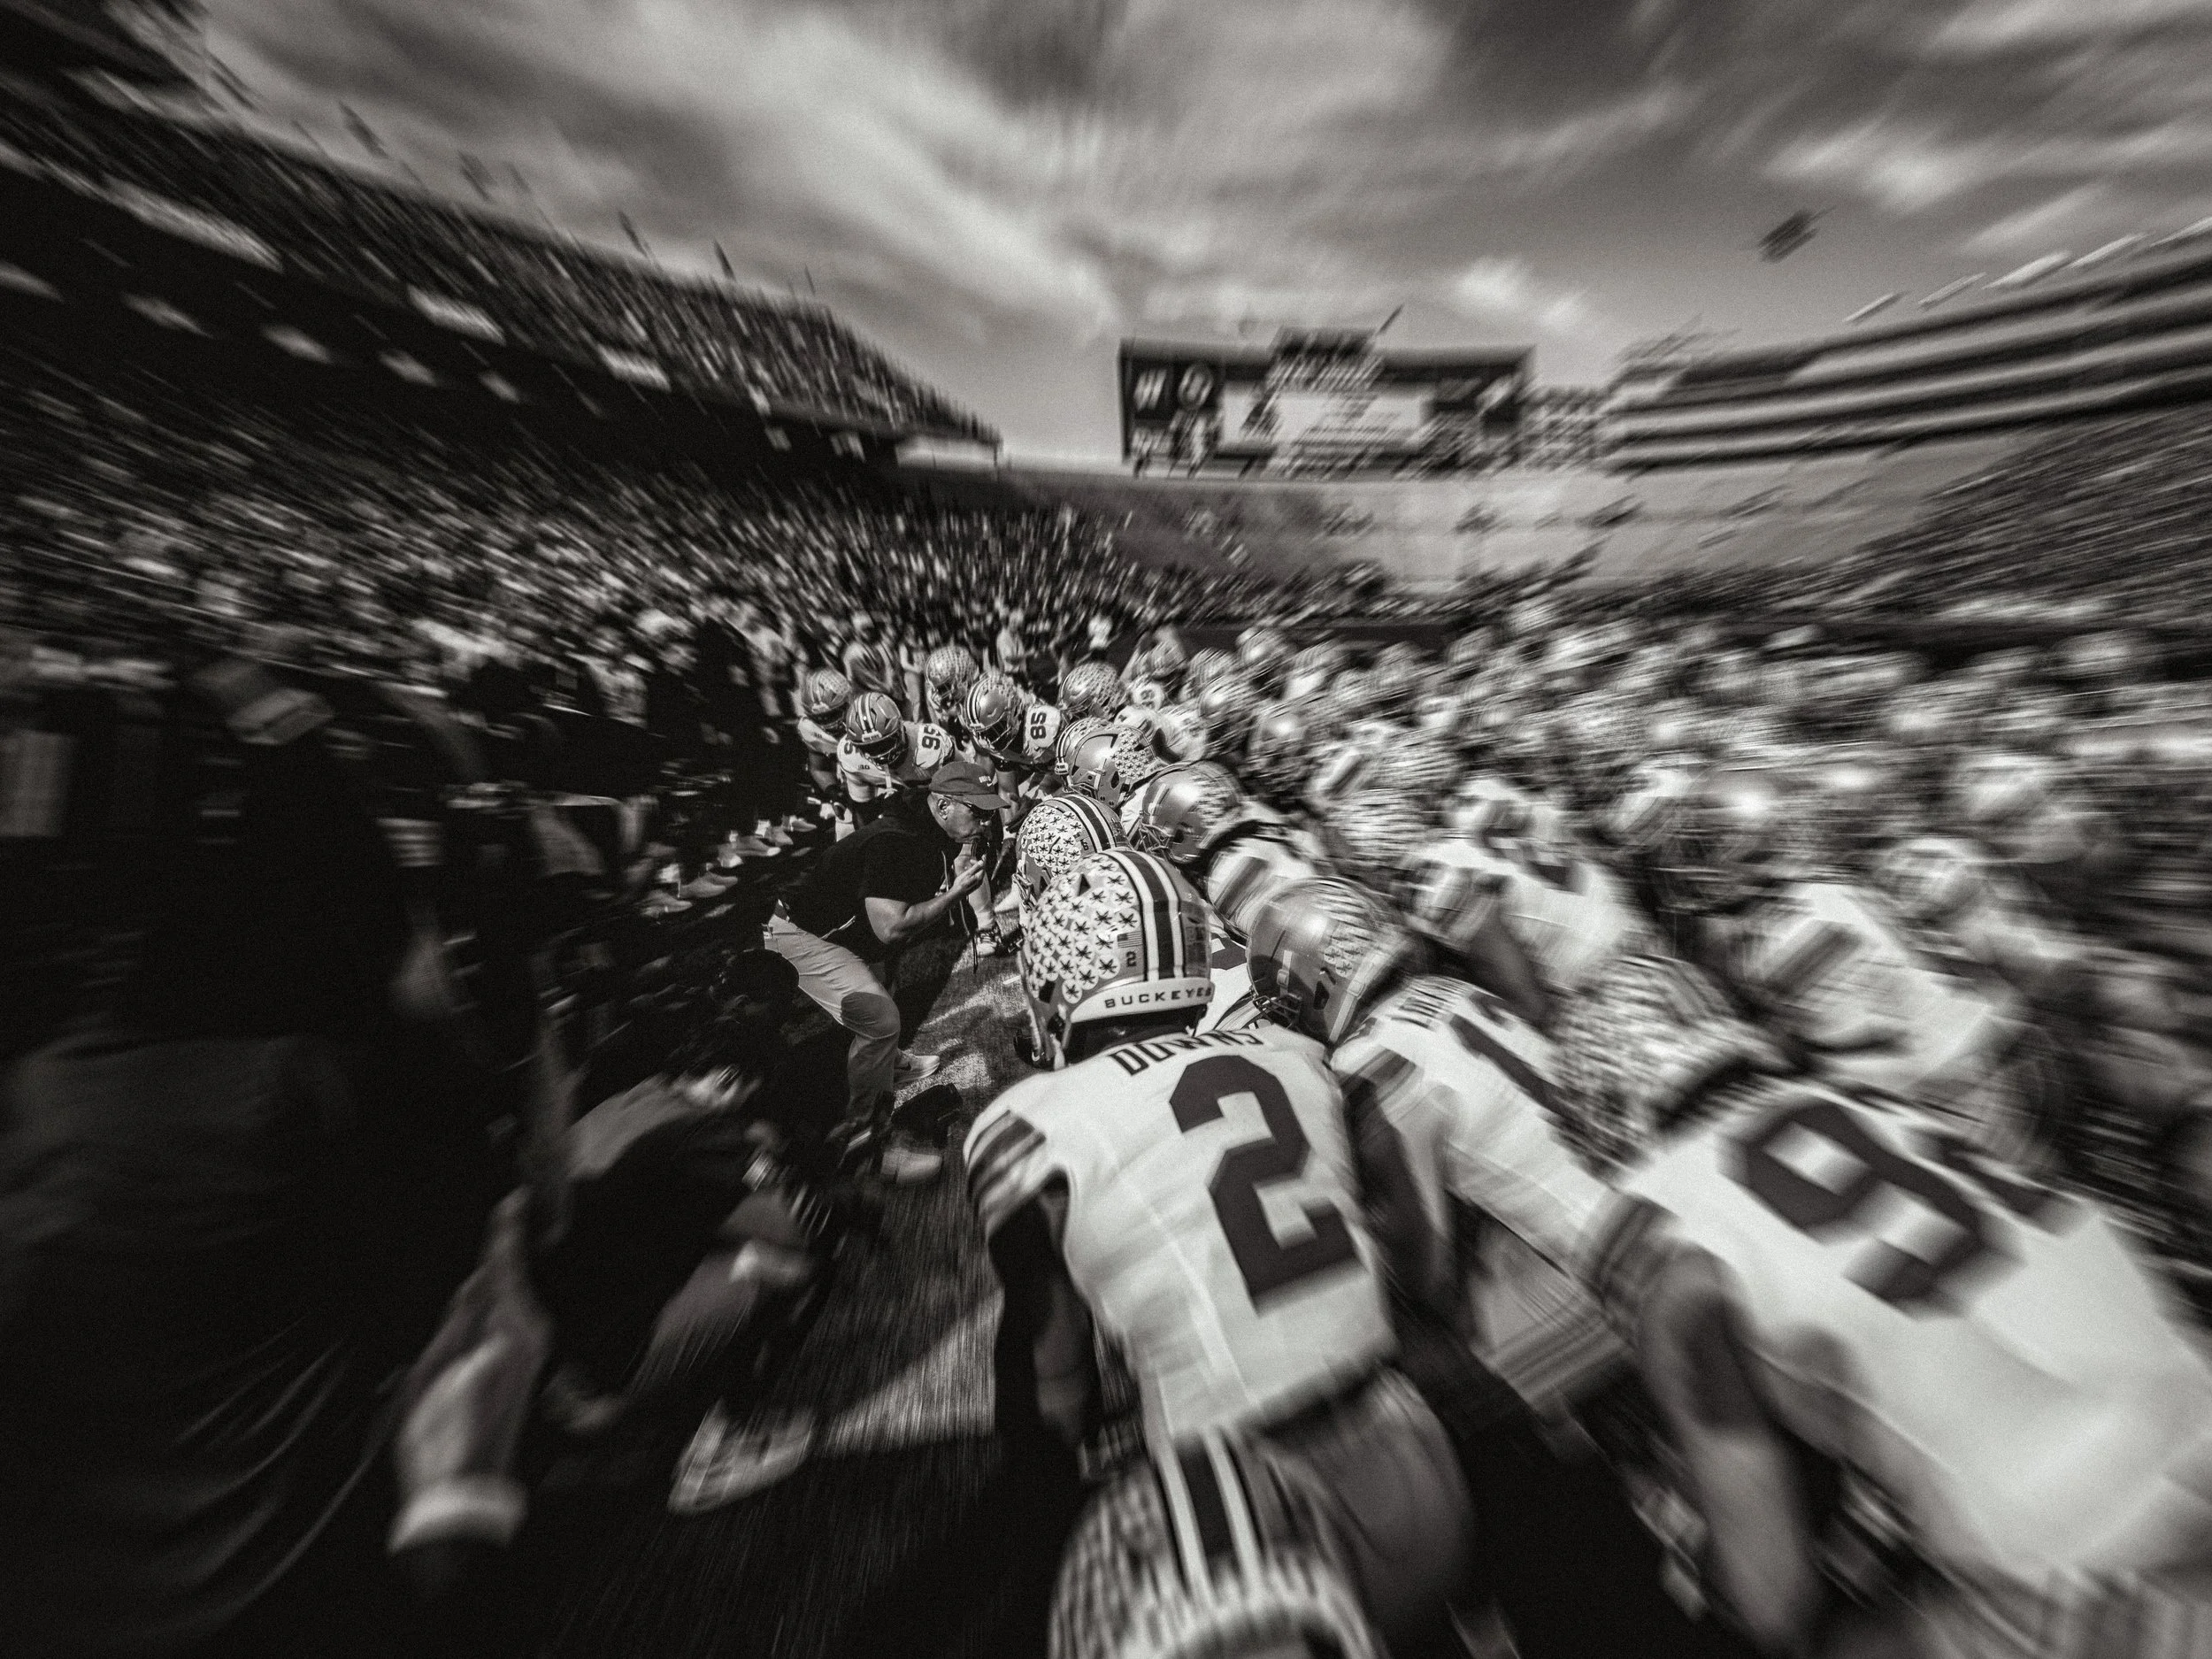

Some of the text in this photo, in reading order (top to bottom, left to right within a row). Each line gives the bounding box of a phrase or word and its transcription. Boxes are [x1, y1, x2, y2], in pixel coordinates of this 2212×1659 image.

[1030, 711, 1047, 740] 85
[1125, 950, 1138, 967] 2
[1169, 1054, 1362, 1304] 2
